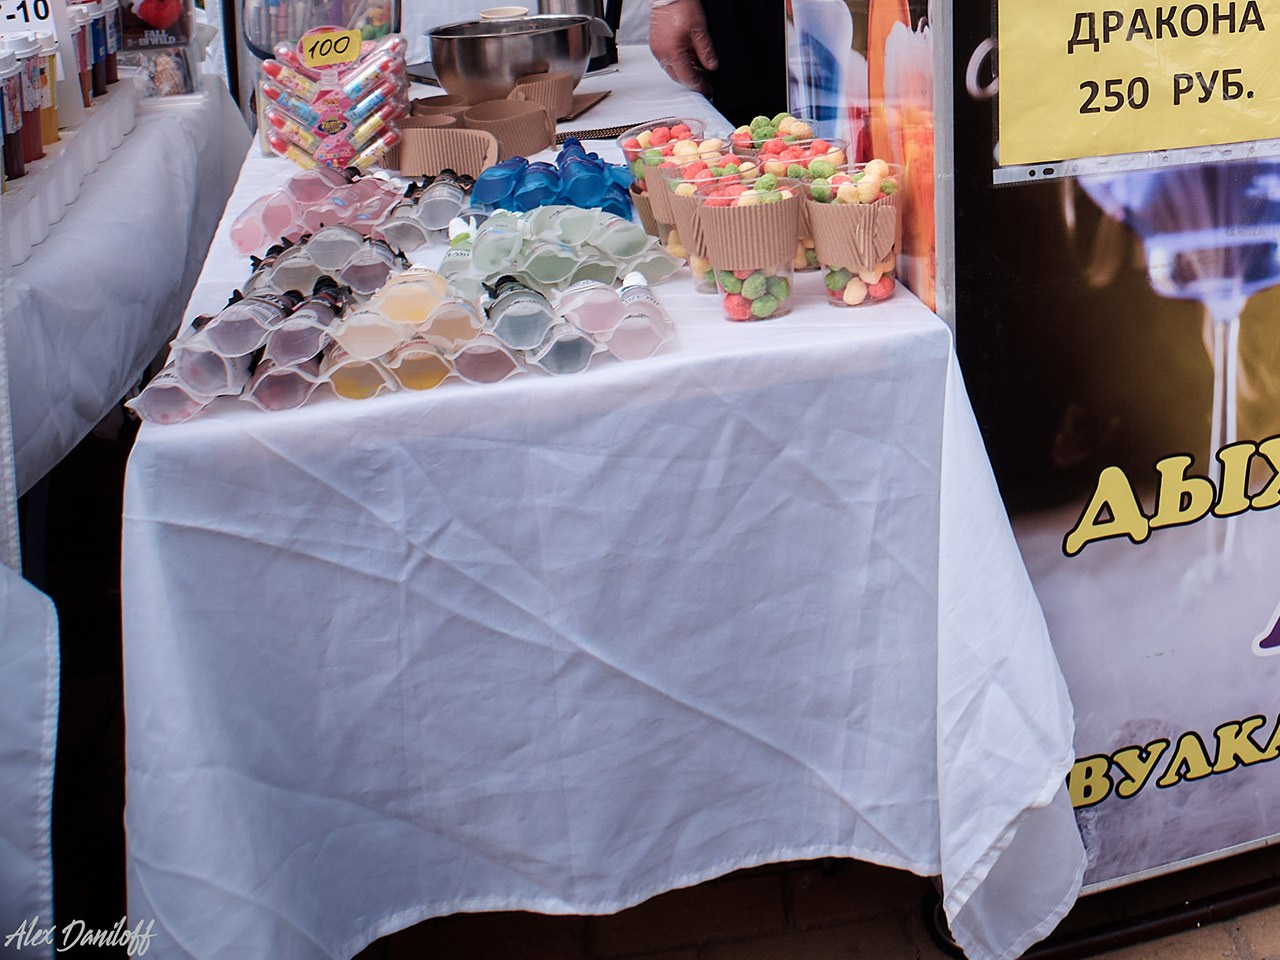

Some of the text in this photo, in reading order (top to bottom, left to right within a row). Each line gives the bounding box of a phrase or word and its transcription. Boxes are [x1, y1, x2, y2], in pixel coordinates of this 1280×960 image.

[308, 36, 350, 60] 100
[1067, 0, 1266, 55] ДРАКОНА
[1079, 68, 1255, 115] 250 РУБ.
